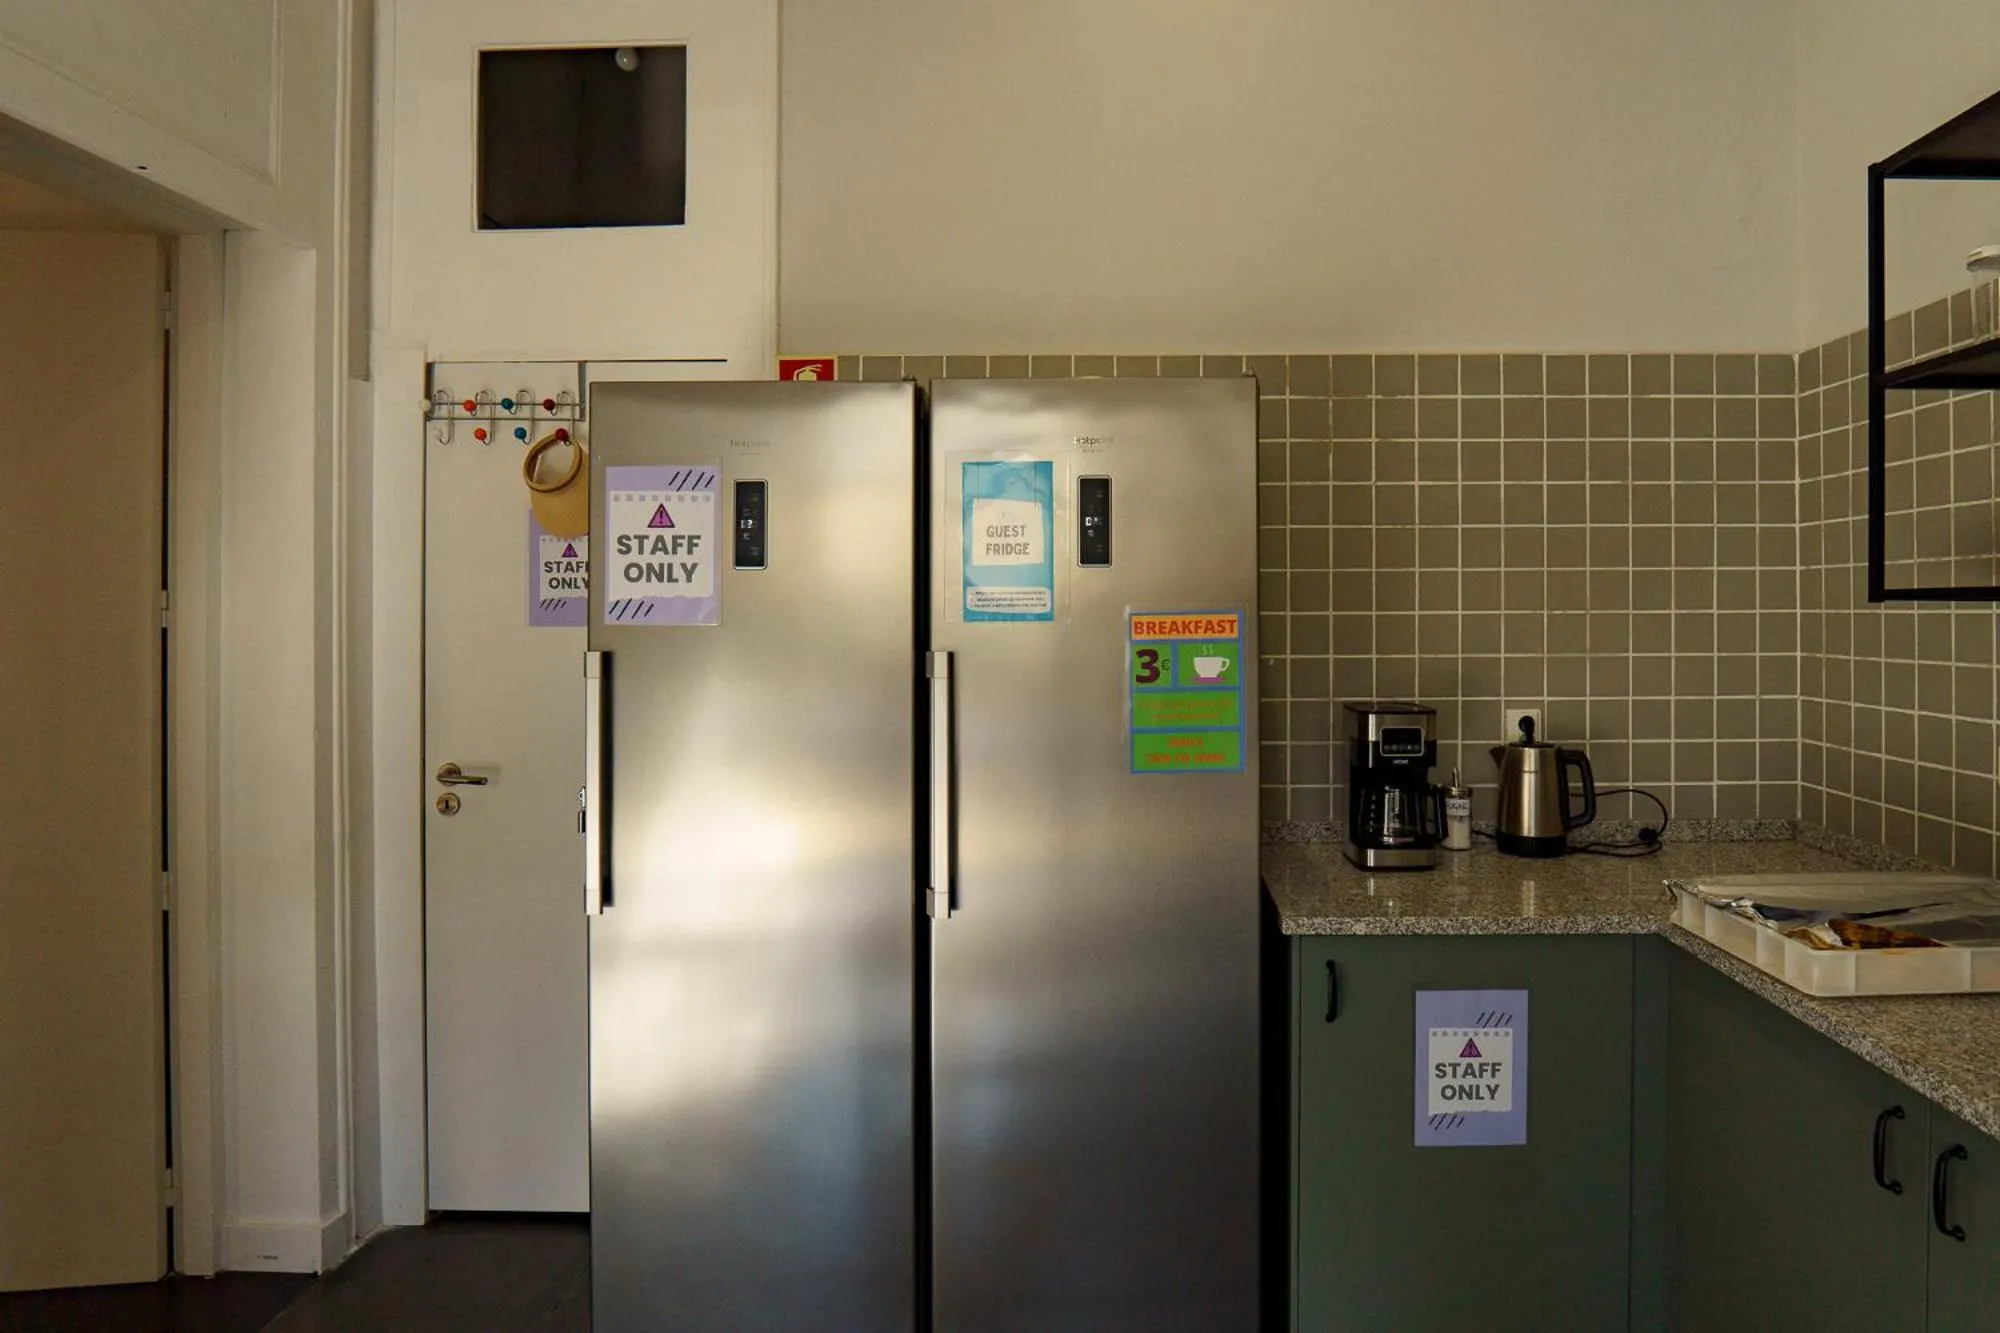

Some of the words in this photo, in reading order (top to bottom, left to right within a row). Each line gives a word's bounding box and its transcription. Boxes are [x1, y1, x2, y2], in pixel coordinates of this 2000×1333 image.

[986, 525, 1028, 539] GUEST
[617, 534, 702, 556] STAFF
[986, 543, 1030, 556] FRIDGE
[623, 562, 699, 584] ONLY
[1133, 619, 1237, 635] BREAKFAST
[1434, 1062, 1502, 1079] STAFF
[1440, 1084, 1500, 1101] ONLY
